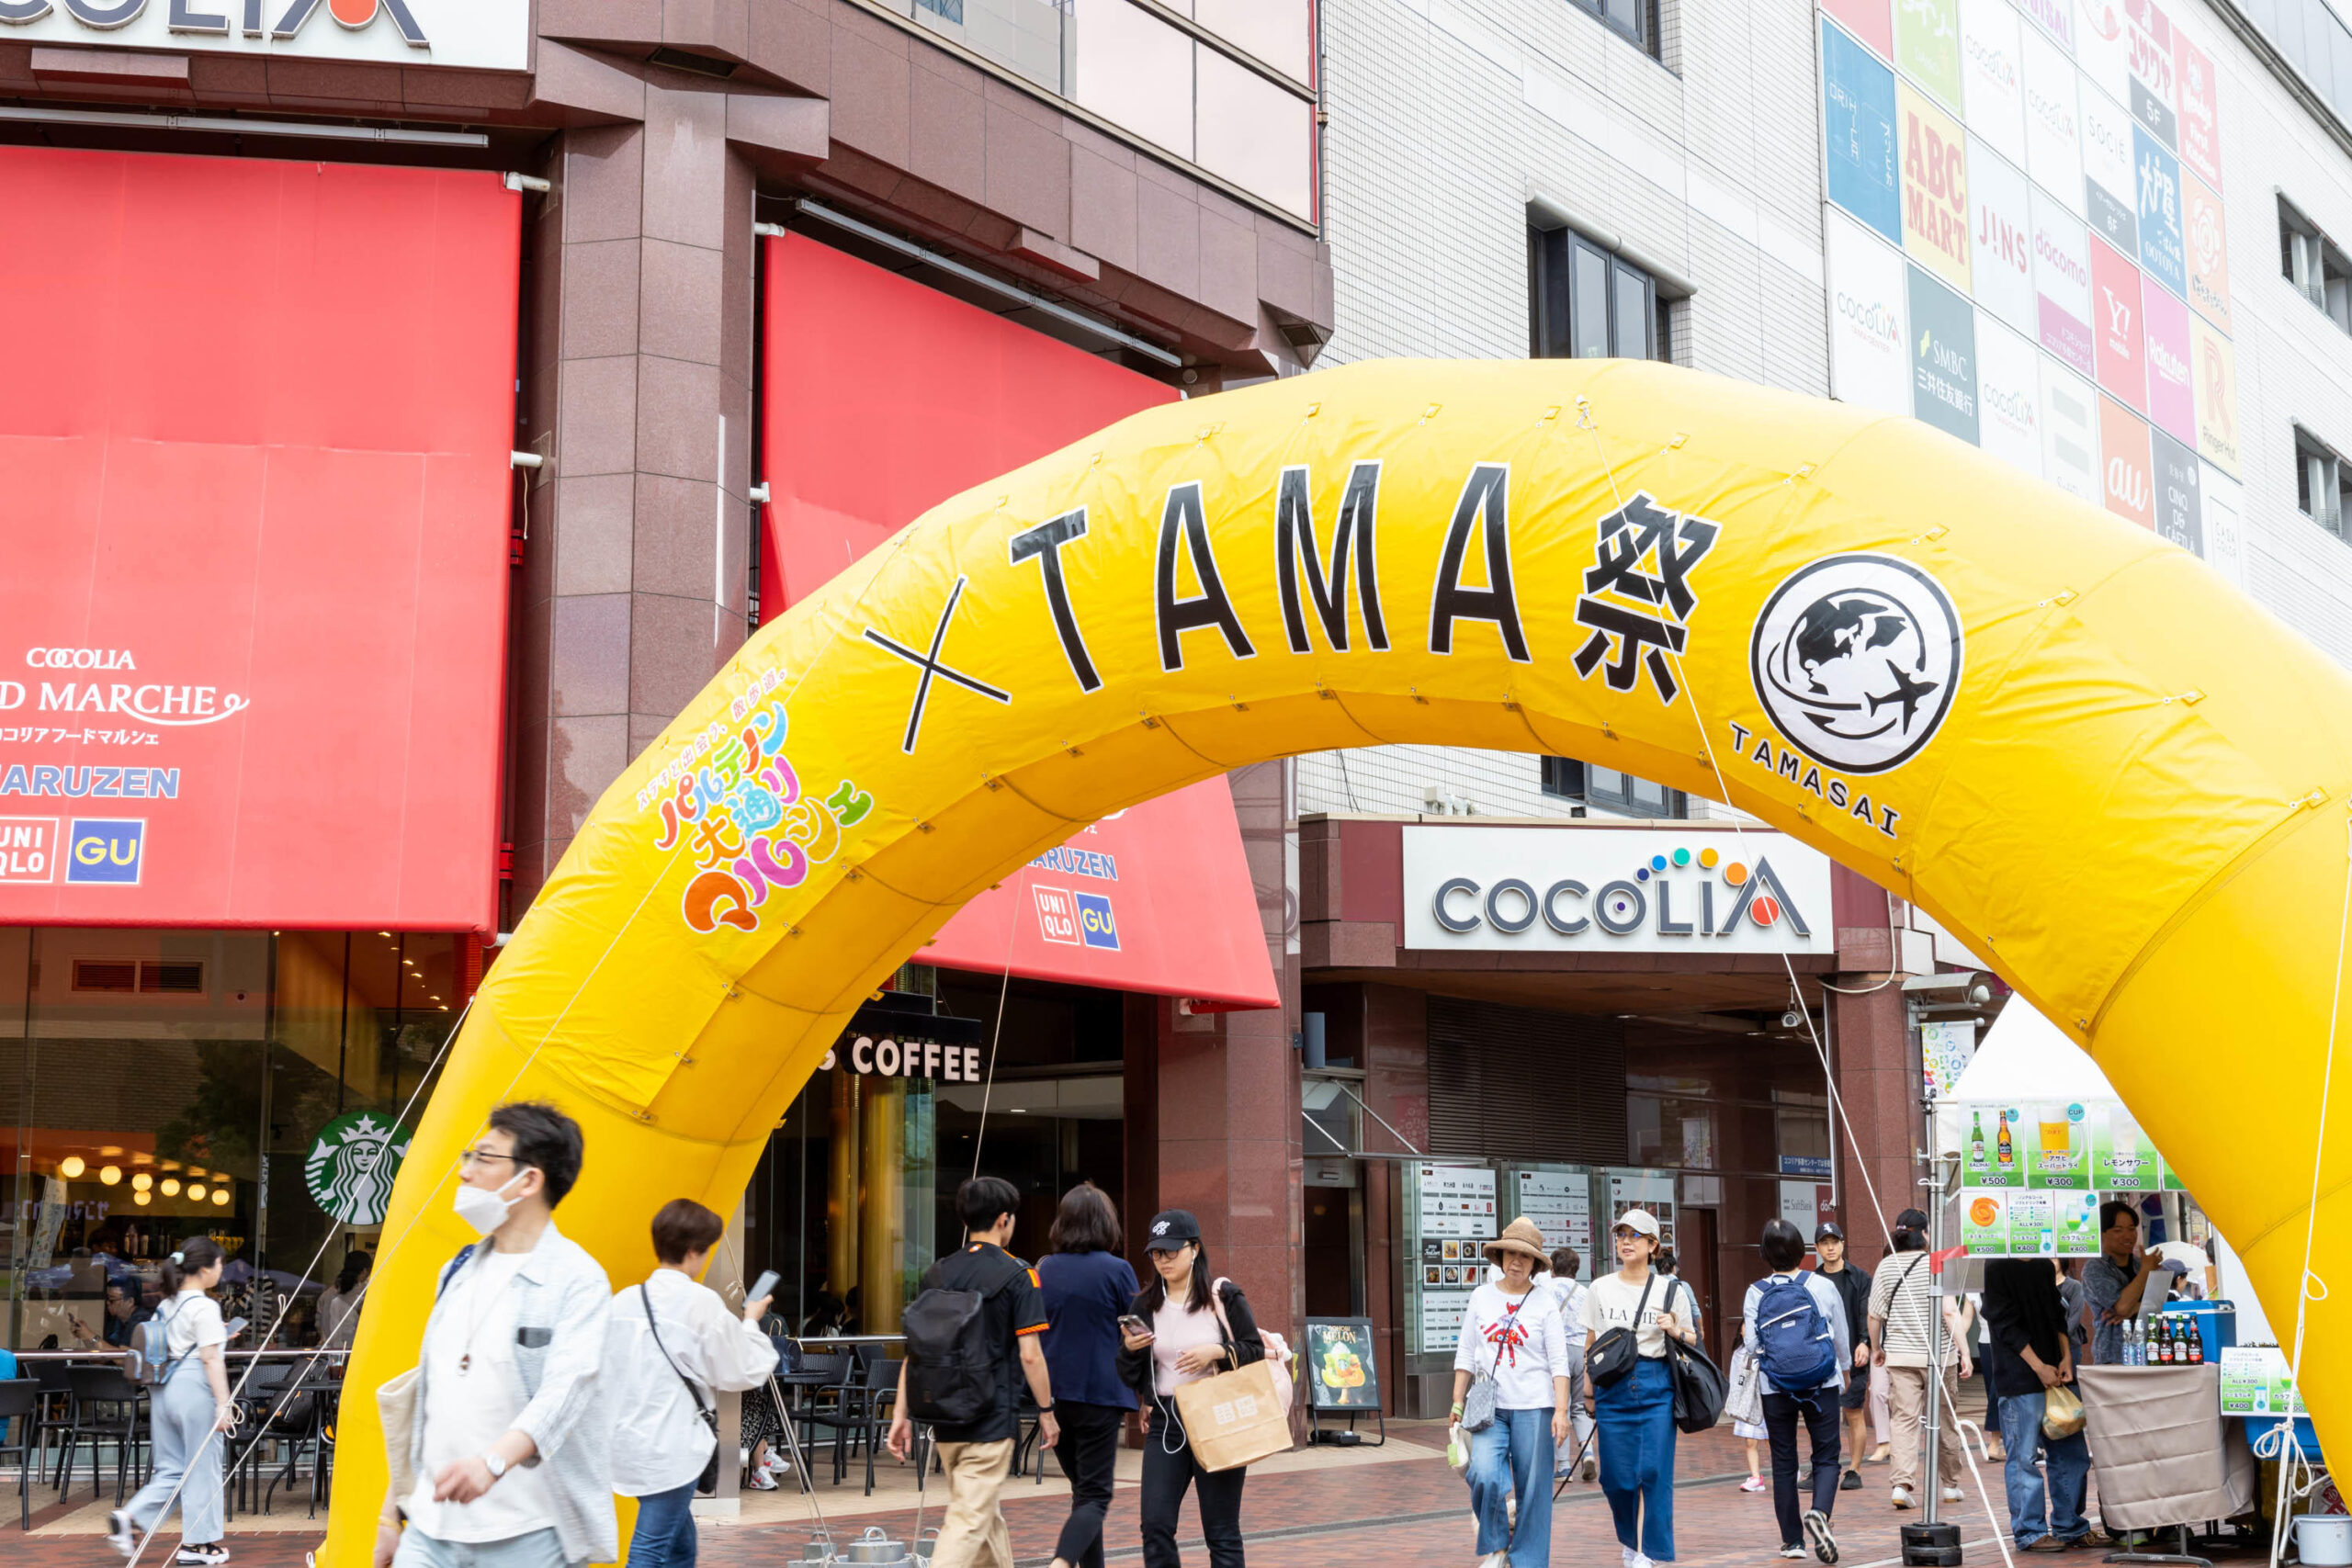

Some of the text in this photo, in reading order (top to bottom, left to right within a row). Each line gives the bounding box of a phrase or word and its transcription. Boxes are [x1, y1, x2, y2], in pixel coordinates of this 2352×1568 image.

[2146, 98, 2161, 127] 5F
[2088, 114, 2126, 164] SOCIE
[1905, 109, 1964, 214] ABC
[1906, 183, 1967, 266] MART
[2035, 228, 2087, 289] docomo
[1837, 291, 1902, 348] COCOLIA
[1932, 339, 1968, 382] SMBC
[1917, 366, 1973, 418] 三井住友銀行
[2108, 457, 2148, 512] au
[26, 647, 137, 671] COCOLIA
[38, 682, 250, 726] MARCHE
[0, 764, 180, 799] ARUZEN
[1730, 721, 1900, 838] TAMASAI
[74, 836, 137, 865] GU
[1027, 846, 1118, 881] ARUZEN
[1039, 893, 1067, 915] UNI
[1433, 852, 1811, 935] COCOLIA
[1045, 915, 1073, 937] QLO
[1082, 908, 1114, 935] GU
[853, 1036, 979, 1082] COFFEE
[2103, 1158, 2149, 1167] レモンサワー
[1981, 1177, 2007, 1185] ¥500
[2047, 1178, 2073, 1186] ¥300
[2112, 1178, 2140, 1187] ¥300
[1609, 1307, 1627, 1321] LA
[1322, 1330, 1356, 1345] MELON
